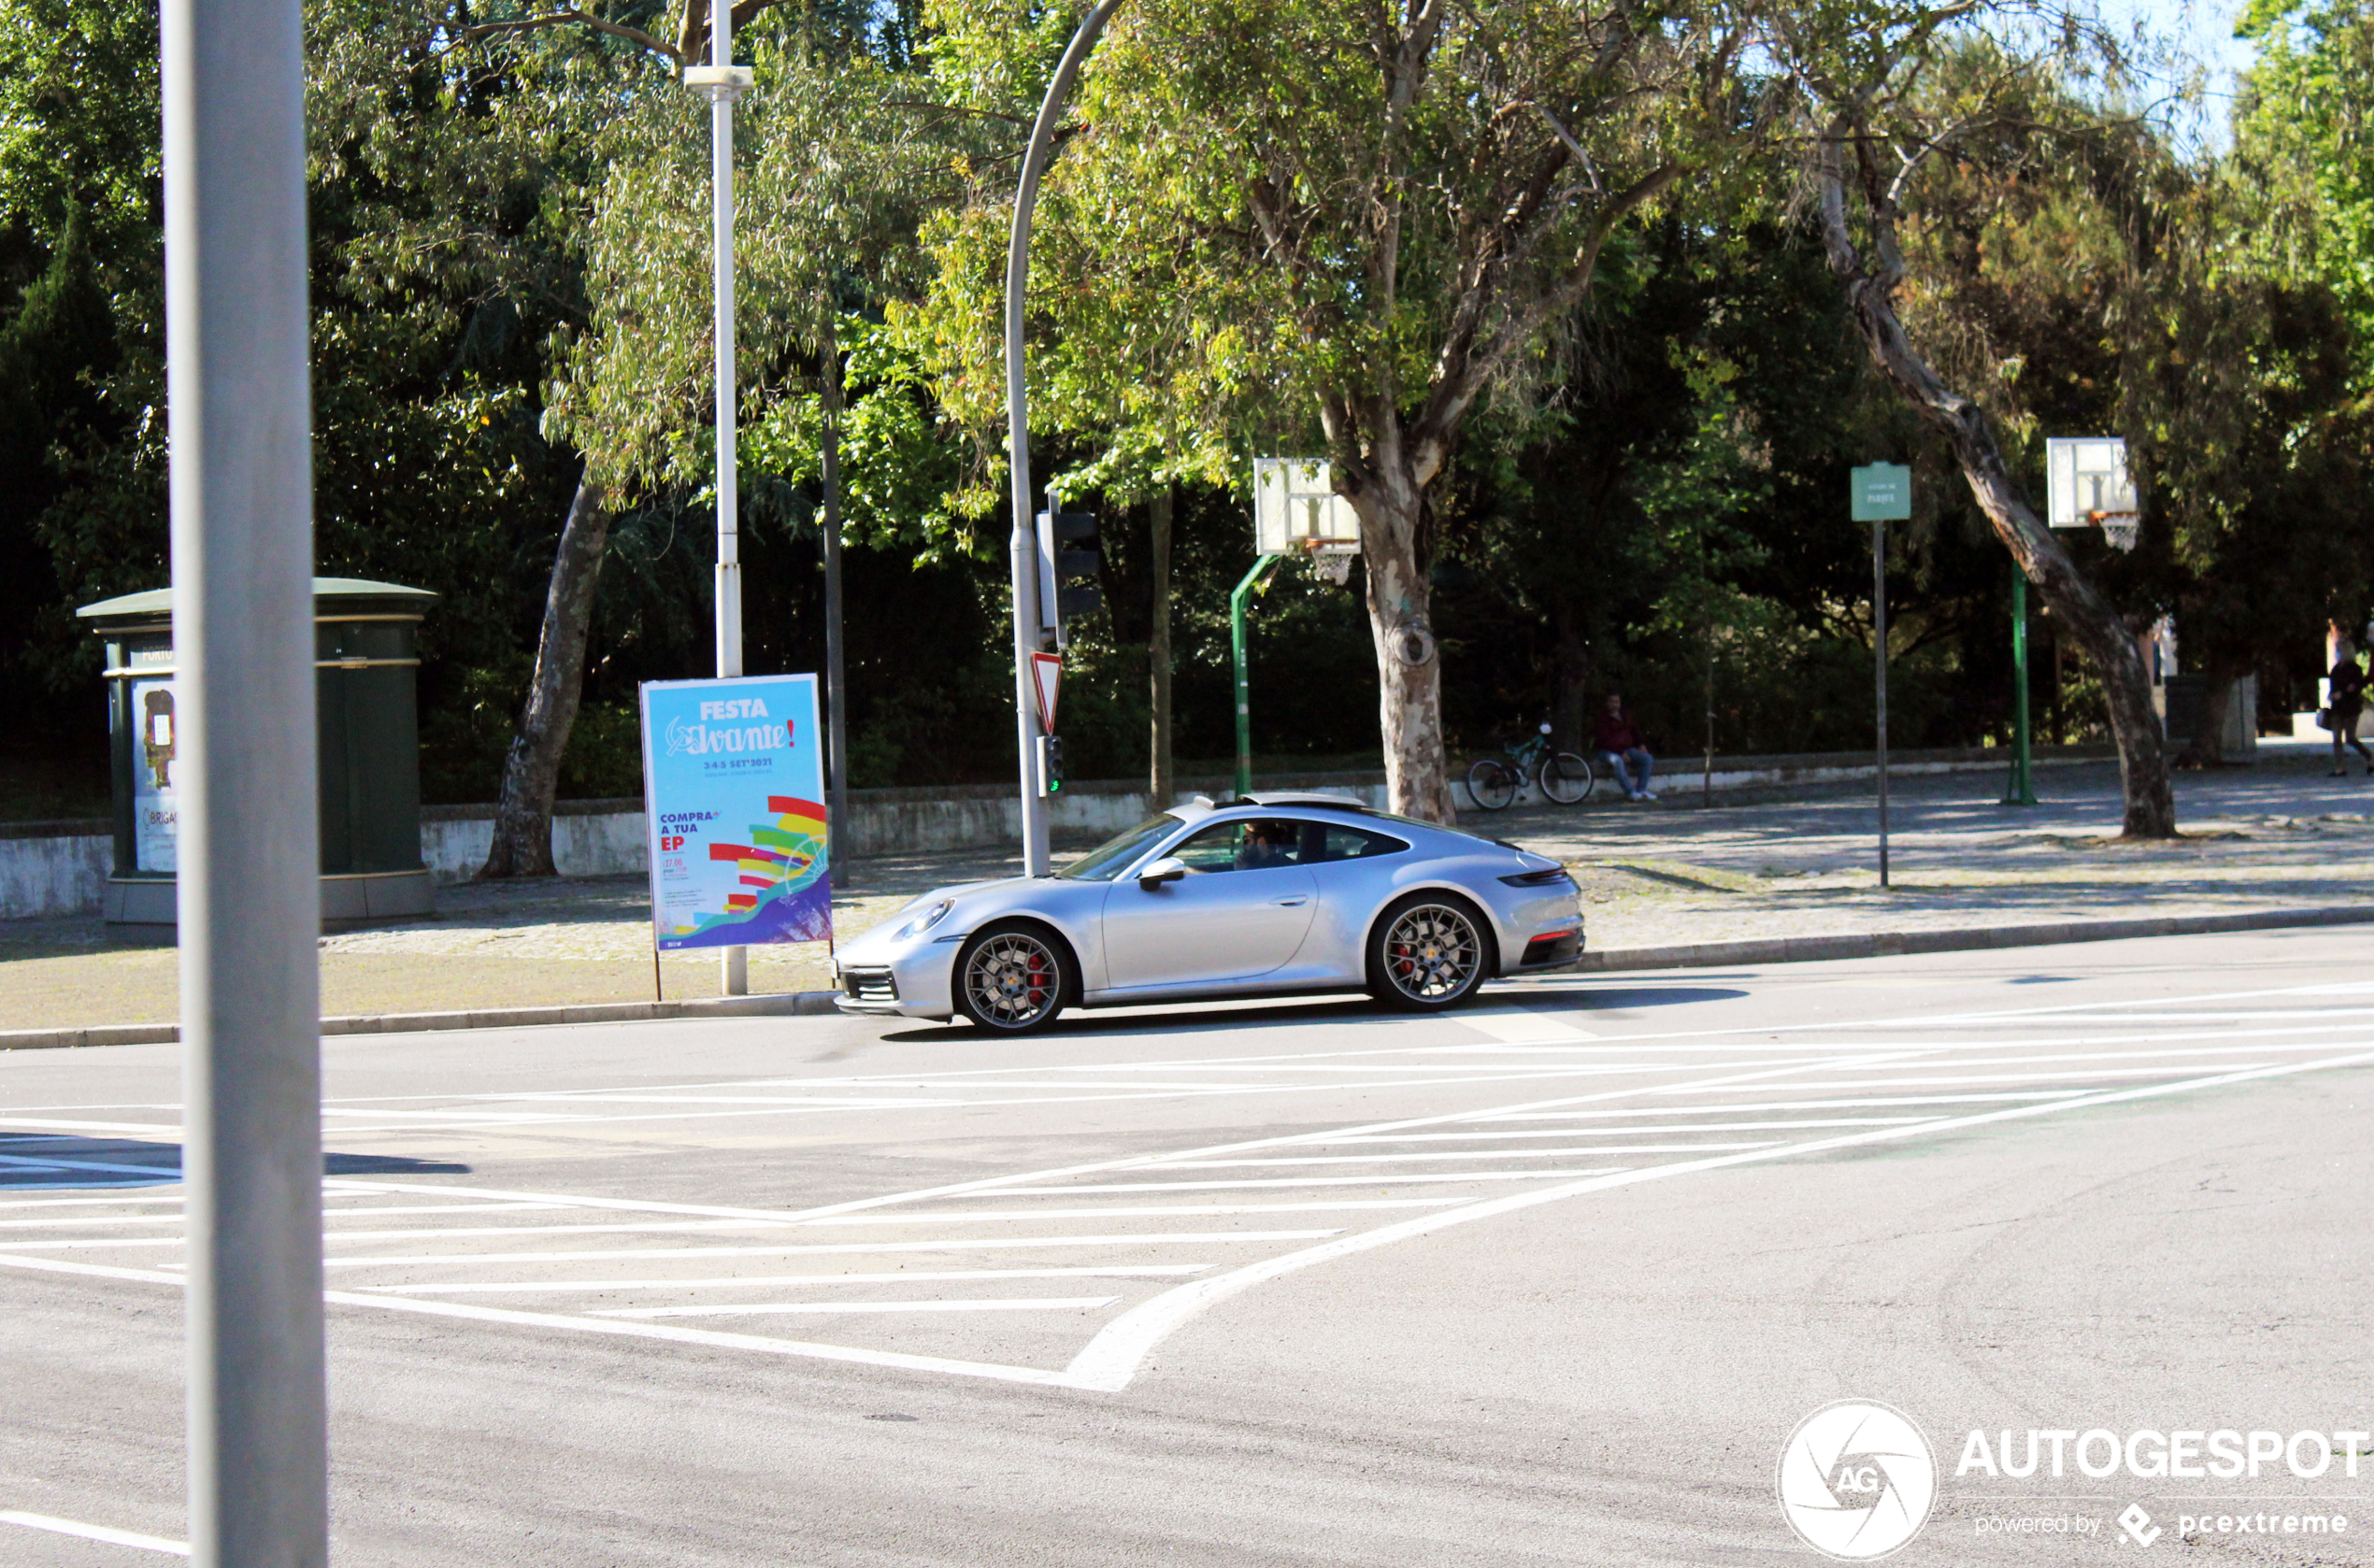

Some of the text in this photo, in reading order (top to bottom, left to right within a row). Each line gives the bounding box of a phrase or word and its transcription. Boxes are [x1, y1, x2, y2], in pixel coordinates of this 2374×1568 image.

[699, 698, 769, 720] FESTA
[660, 811, 713, 823] COMPRA
[661, 823, 698, 834] A TUA
[661, 835, 685, 851] EP
